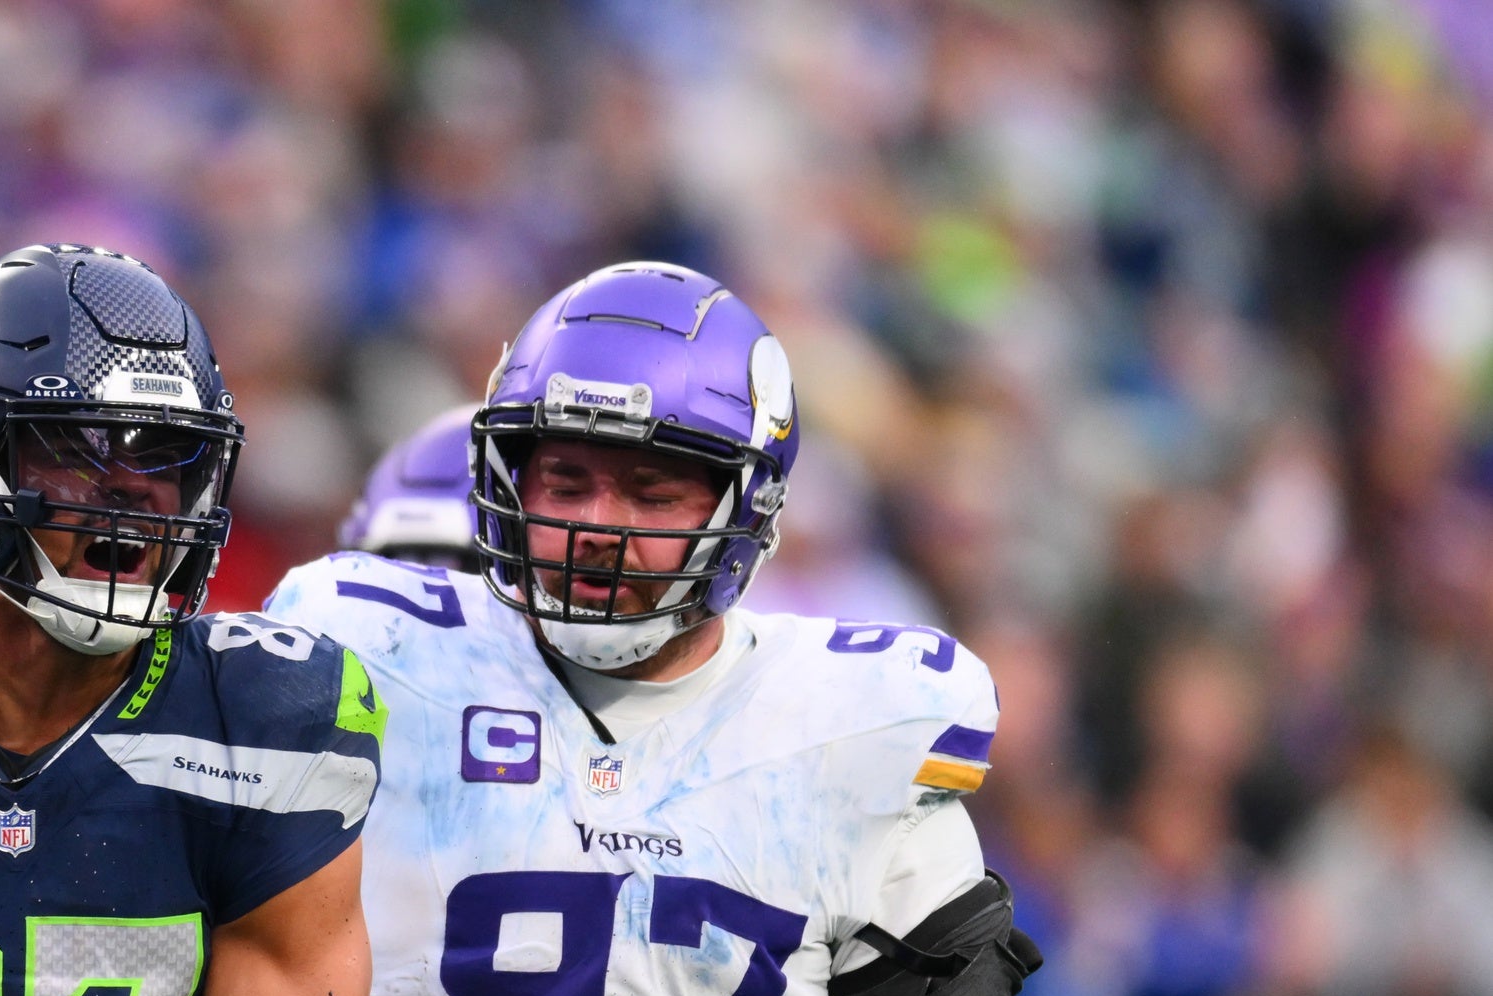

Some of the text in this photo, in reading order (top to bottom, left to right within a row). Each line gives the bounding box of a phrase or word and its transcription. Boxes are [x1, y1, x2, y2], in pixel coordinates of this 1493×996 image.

[132, 377, 183, 394] SEAHAWKS
[468, 711, 536, 763] C
[592, 770, 618, 789] NFL
[2, 829, 29, 848] NFL
